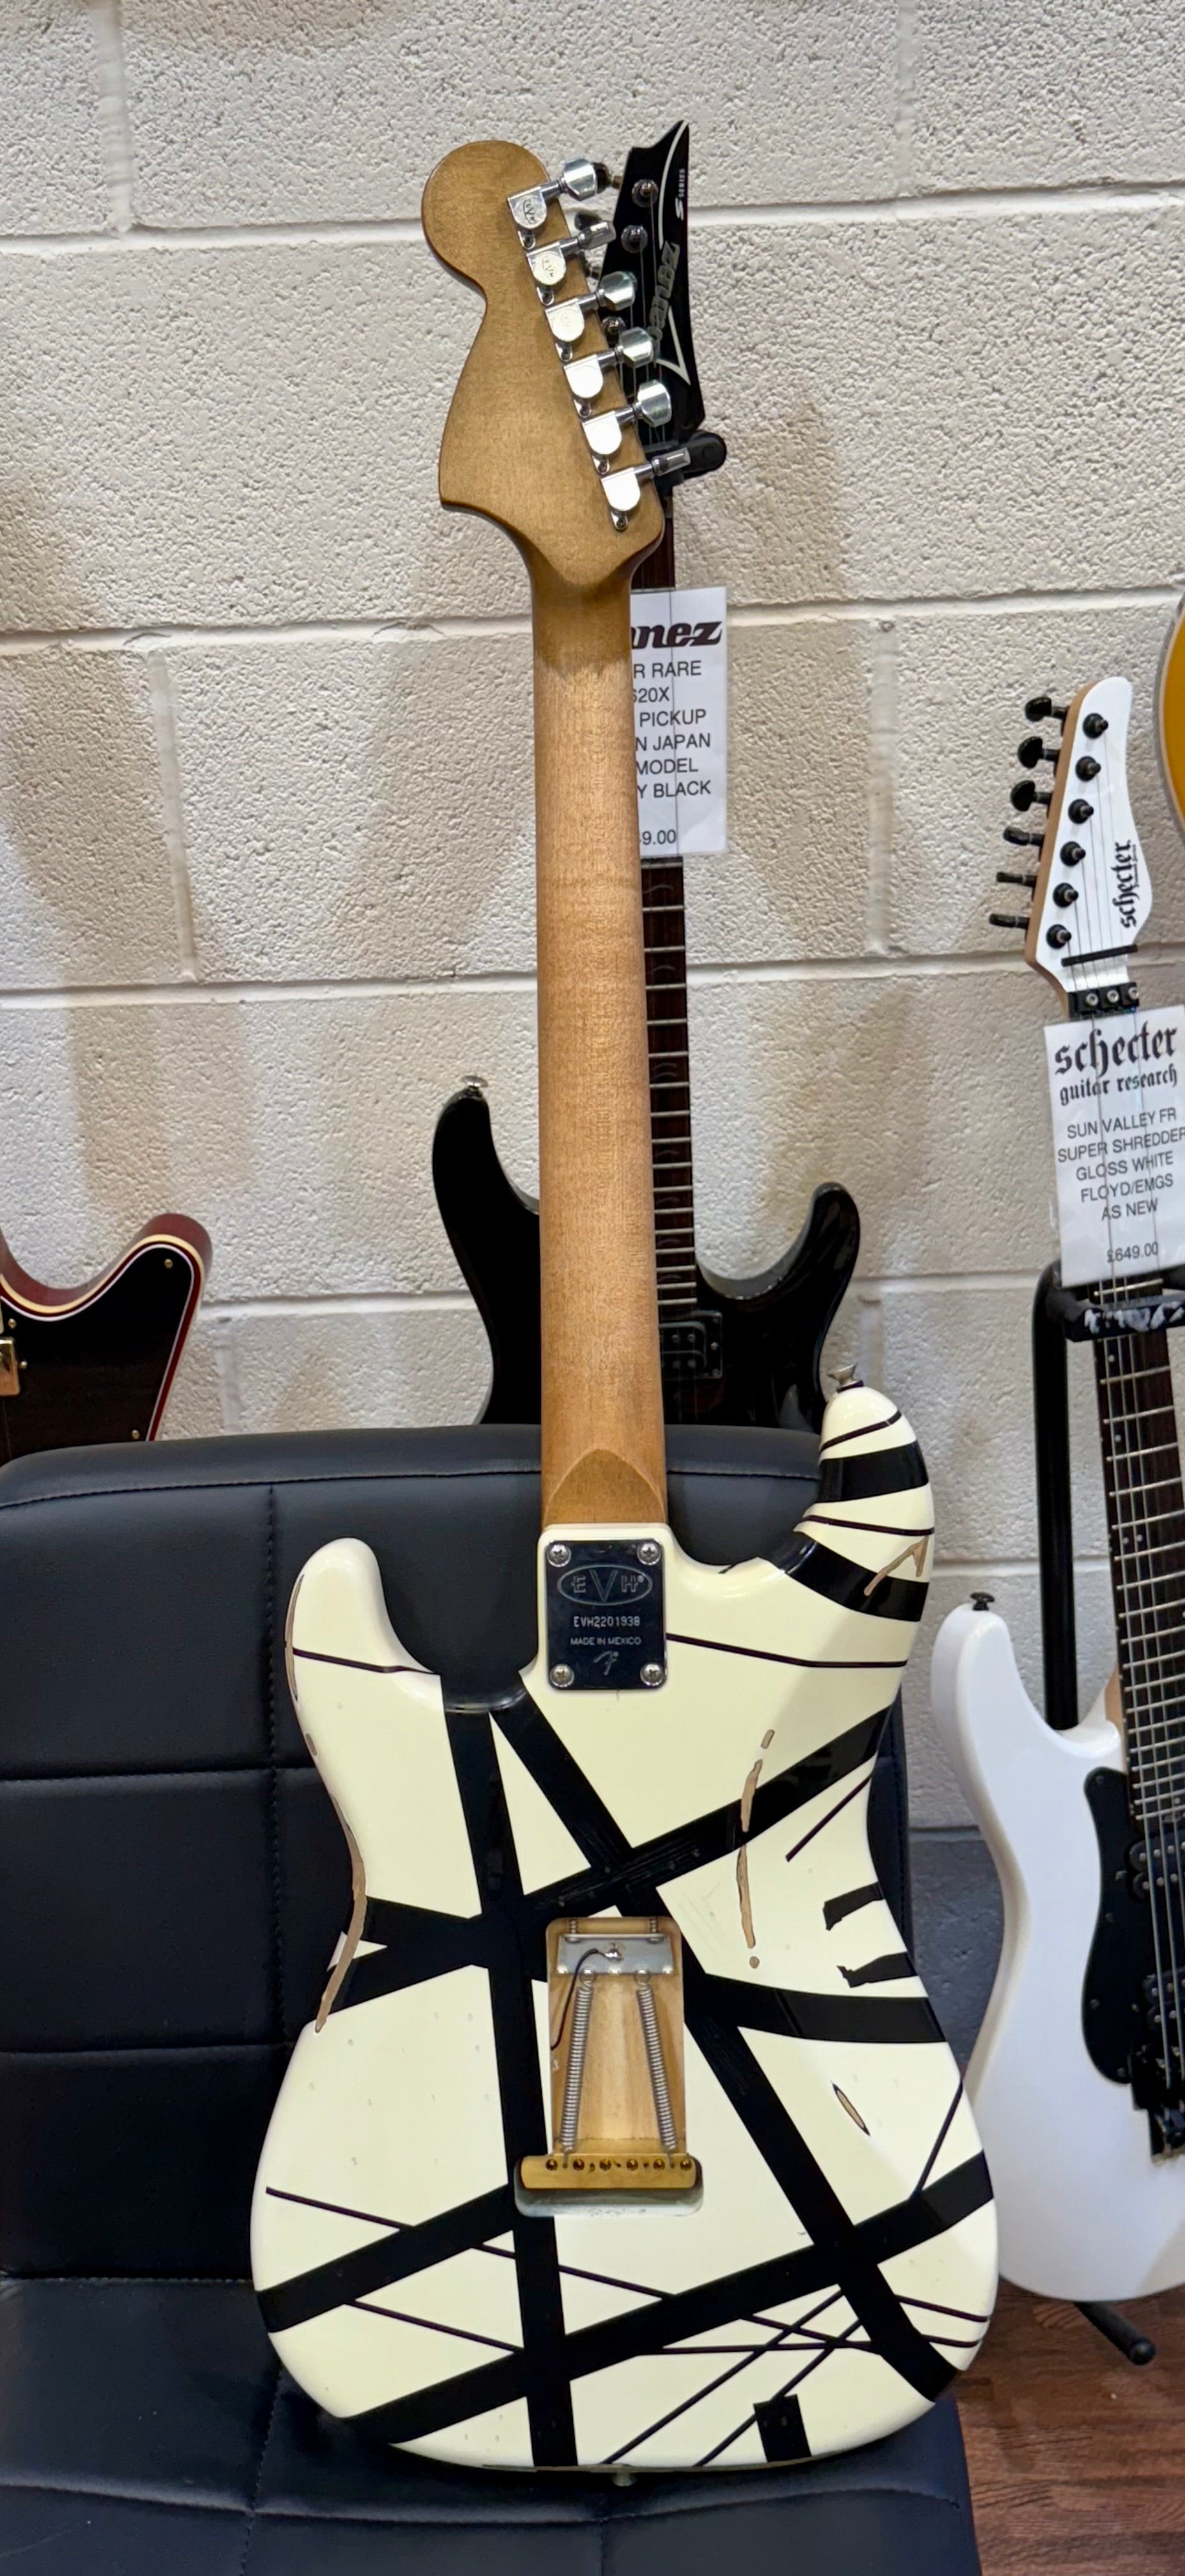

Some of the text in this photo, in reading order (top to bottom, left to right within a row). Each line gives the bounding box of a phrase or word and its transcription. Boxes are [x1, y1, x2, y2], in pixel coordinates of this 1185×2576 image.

[652, 660, 701, 678] RARE
[639, 709, 706, 727] PICKUP
[653, 733, 710, 751] JAPAN
[636, 758, 698, 775] MODEL
[654, 780, 711, 798] BLACK
[639, 829, 676, 845] 9.00
[1110, 839, 1140, 928] schecter
[1055, 1020, 1177, 1078] schecter
[1060, 1063, 1177, 1107] guitar research
[1067, 1107, 1177, 1139] SUN VALLEY FR
[1058, 1126, 1185, 1163] SUPER SHREDDER
[1076, 1151, 1174, 1181] GLOSS WHITE
[1081, 1173, 1174, 1203] FLOYD/EMGS
[1101, 1197, 1158, 1221] AS NEW
[1107, 1241, 1159, 1263] £649.00
[573, 1616, 640, 1629] EVH2201938
[570, 1637, 641, 1646] MADE IN MEXICO
